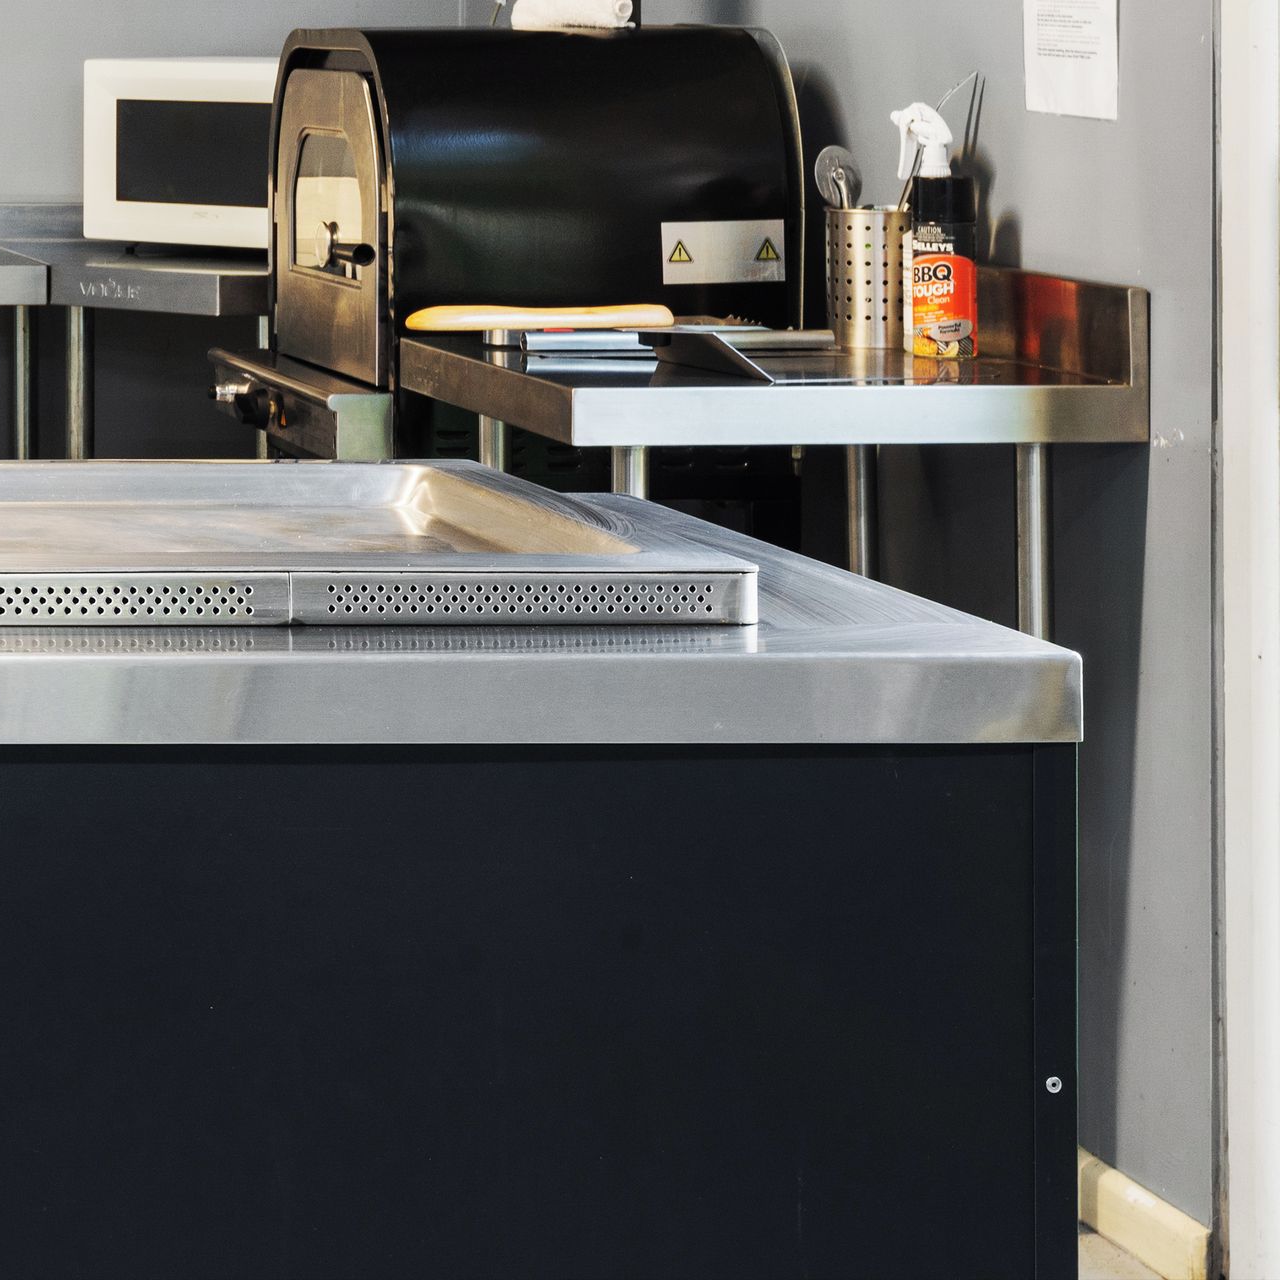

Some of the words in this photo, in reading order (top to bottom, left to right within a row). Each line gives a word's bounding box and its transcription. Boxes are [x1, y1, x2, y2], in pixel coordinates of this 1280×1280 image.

[918, 226, 942, 234] CAUTION
[913, 263, 953, 284] BBQ
[928, 296, 950, 305] Clean
